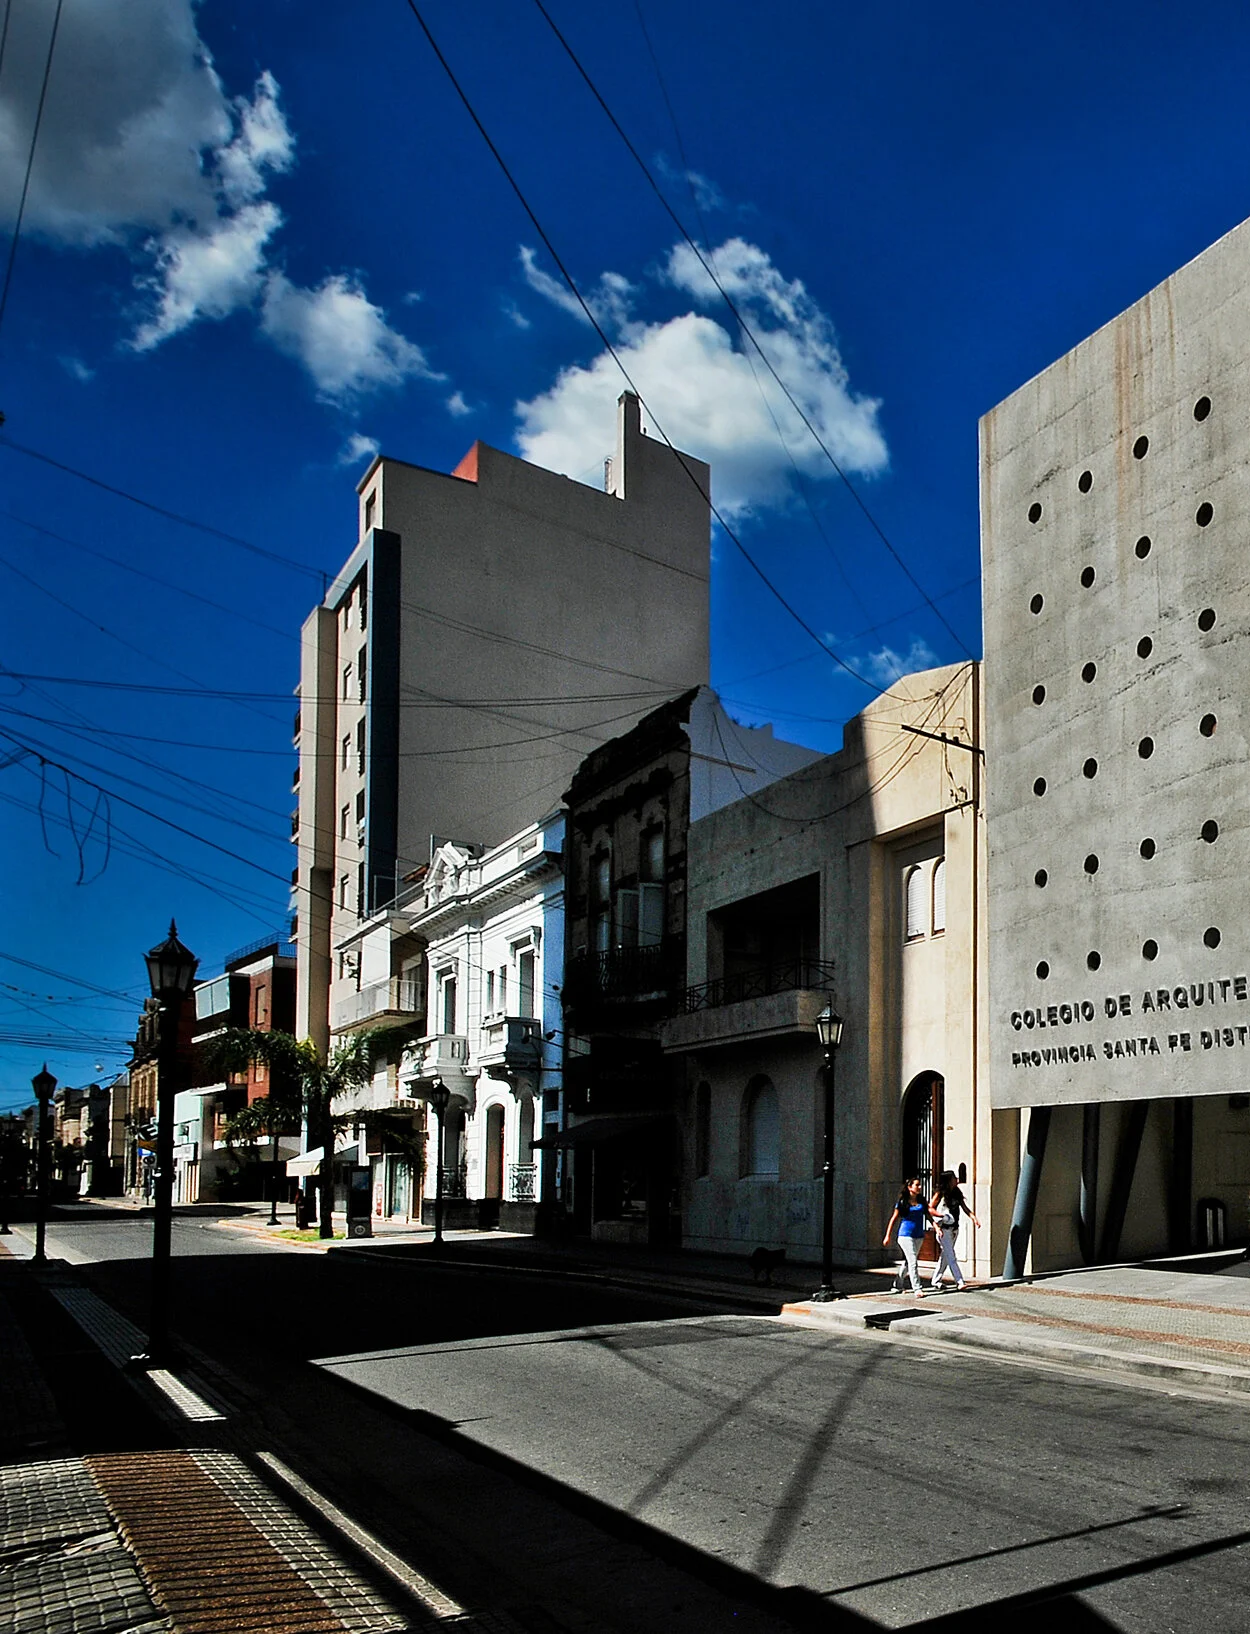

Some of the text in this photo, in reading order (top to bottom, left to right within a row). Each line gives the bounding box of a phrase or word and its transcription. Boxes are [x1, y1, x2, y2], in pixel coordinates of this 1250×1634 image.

[1010, 1000, 1095, 1031] COLEGIO
[1104, 994, 1132, 1019] DE
[1011, 1043, 1097, 1068] PROVINCIA
[1103, 1036, 1161, 1060] SANTA
[1168, 1032, 1192, 1053] FE
